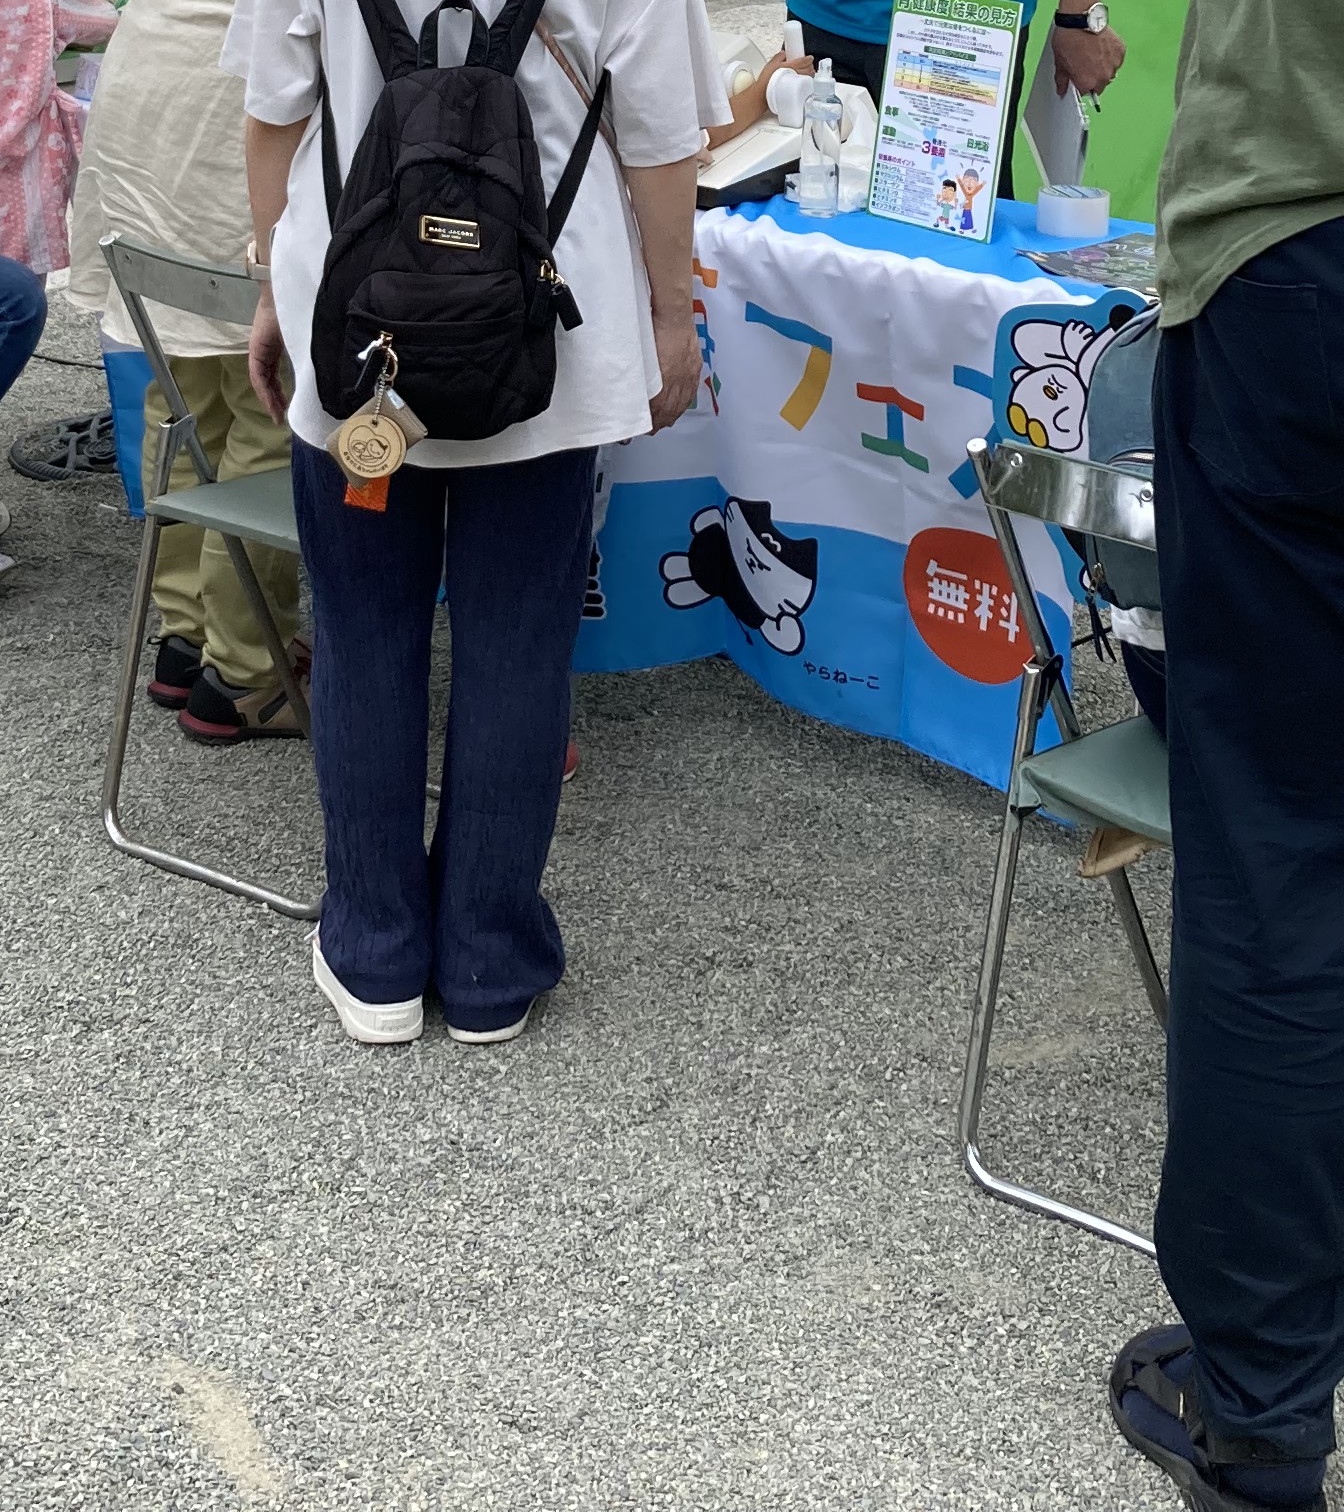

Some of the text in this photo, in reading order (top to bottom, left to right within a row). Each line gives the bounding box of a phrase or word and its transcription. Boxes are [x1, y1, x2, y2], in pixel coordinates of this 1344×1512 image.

[953, 0, 1016, 27] 結果の見方
[925, 558, 1020, 643] 無料
[803, 661, 880, 690] やらねーこ
